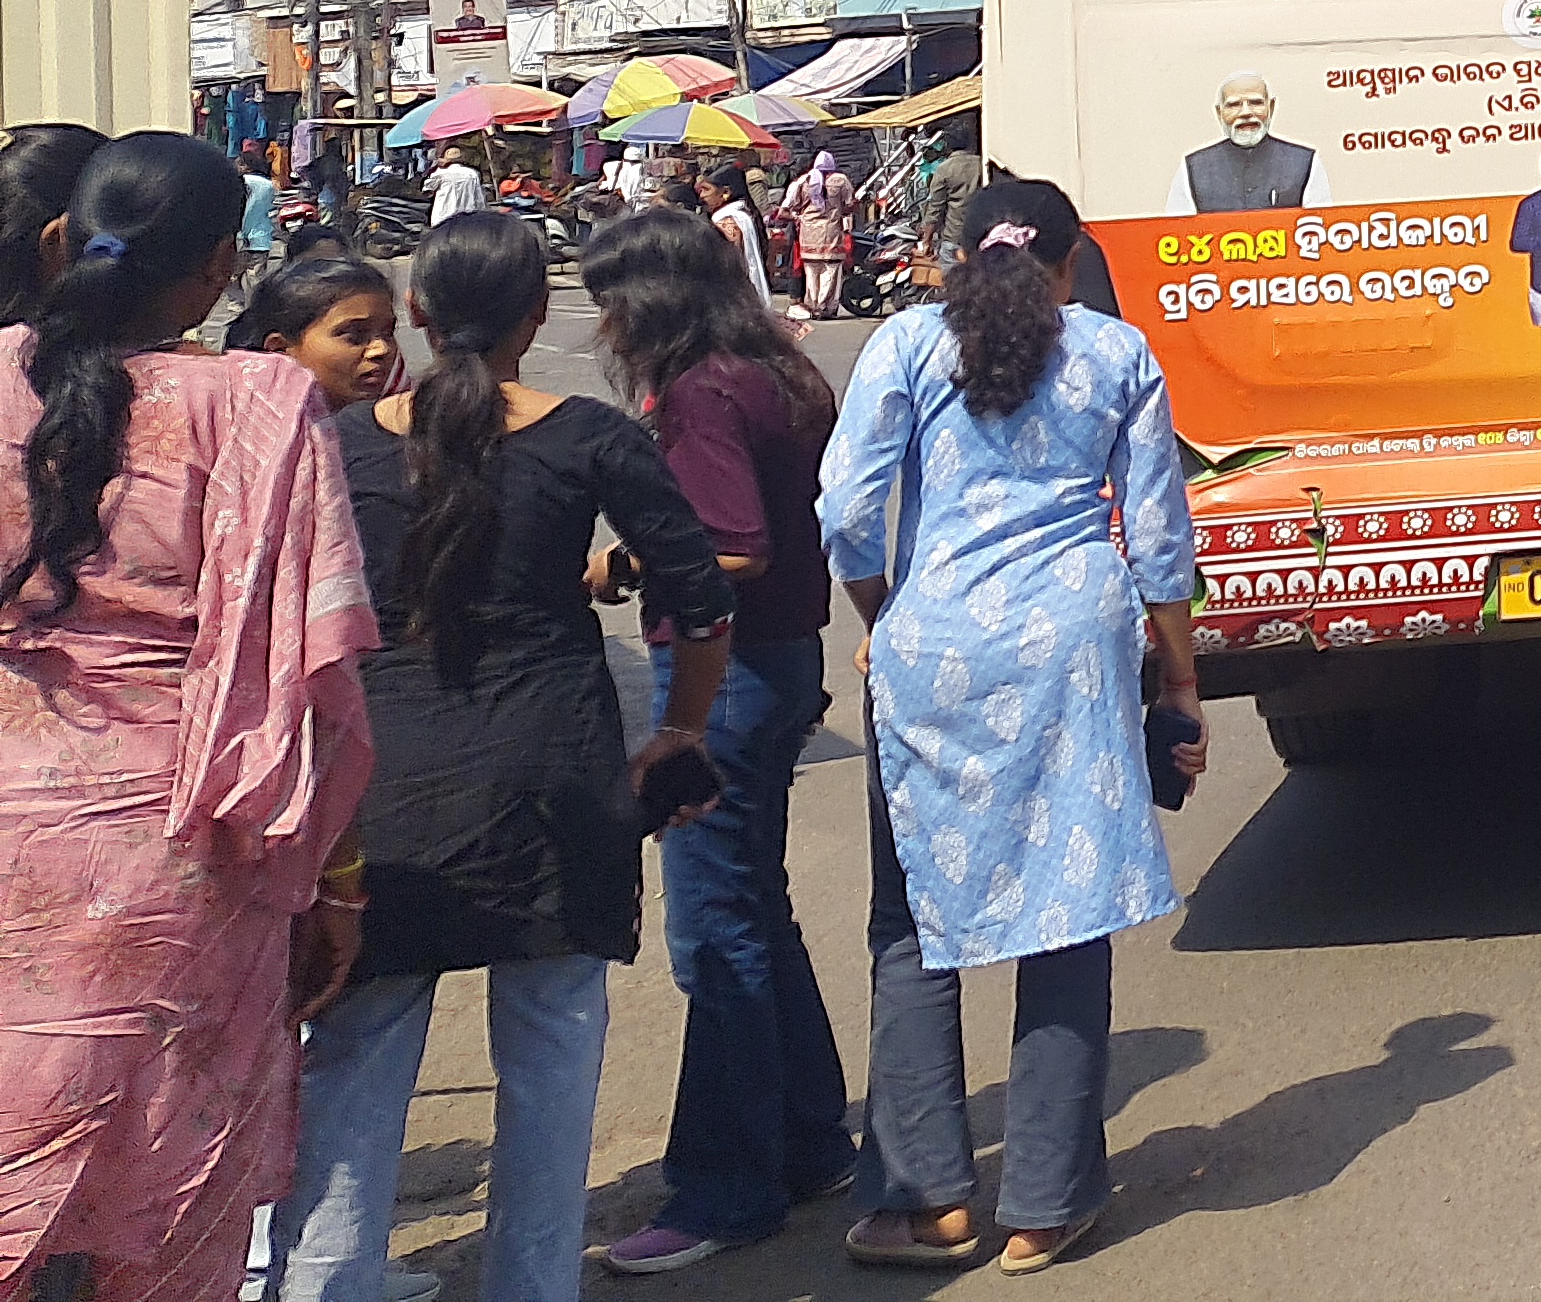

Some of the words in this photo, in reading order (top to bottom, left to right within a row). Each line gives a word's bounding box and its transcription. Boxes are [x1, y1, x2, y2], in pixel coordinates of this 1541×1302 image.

[1432, 62, 1506, 85] ଭାରତ
[1458, 125, 1502, 145] ଜନ
[1218, 228, 1288, 263] ଲକ୍ଷ
[1294, 211, 1489, 261] ହିତାଧିକାରୀ
[1157, 273, 1222, 321] ପ୍ରତି
[1229, 272, 1354, 310] ମାସରେ
[1359, 263, 1490, 309] ଉପକୃତ
